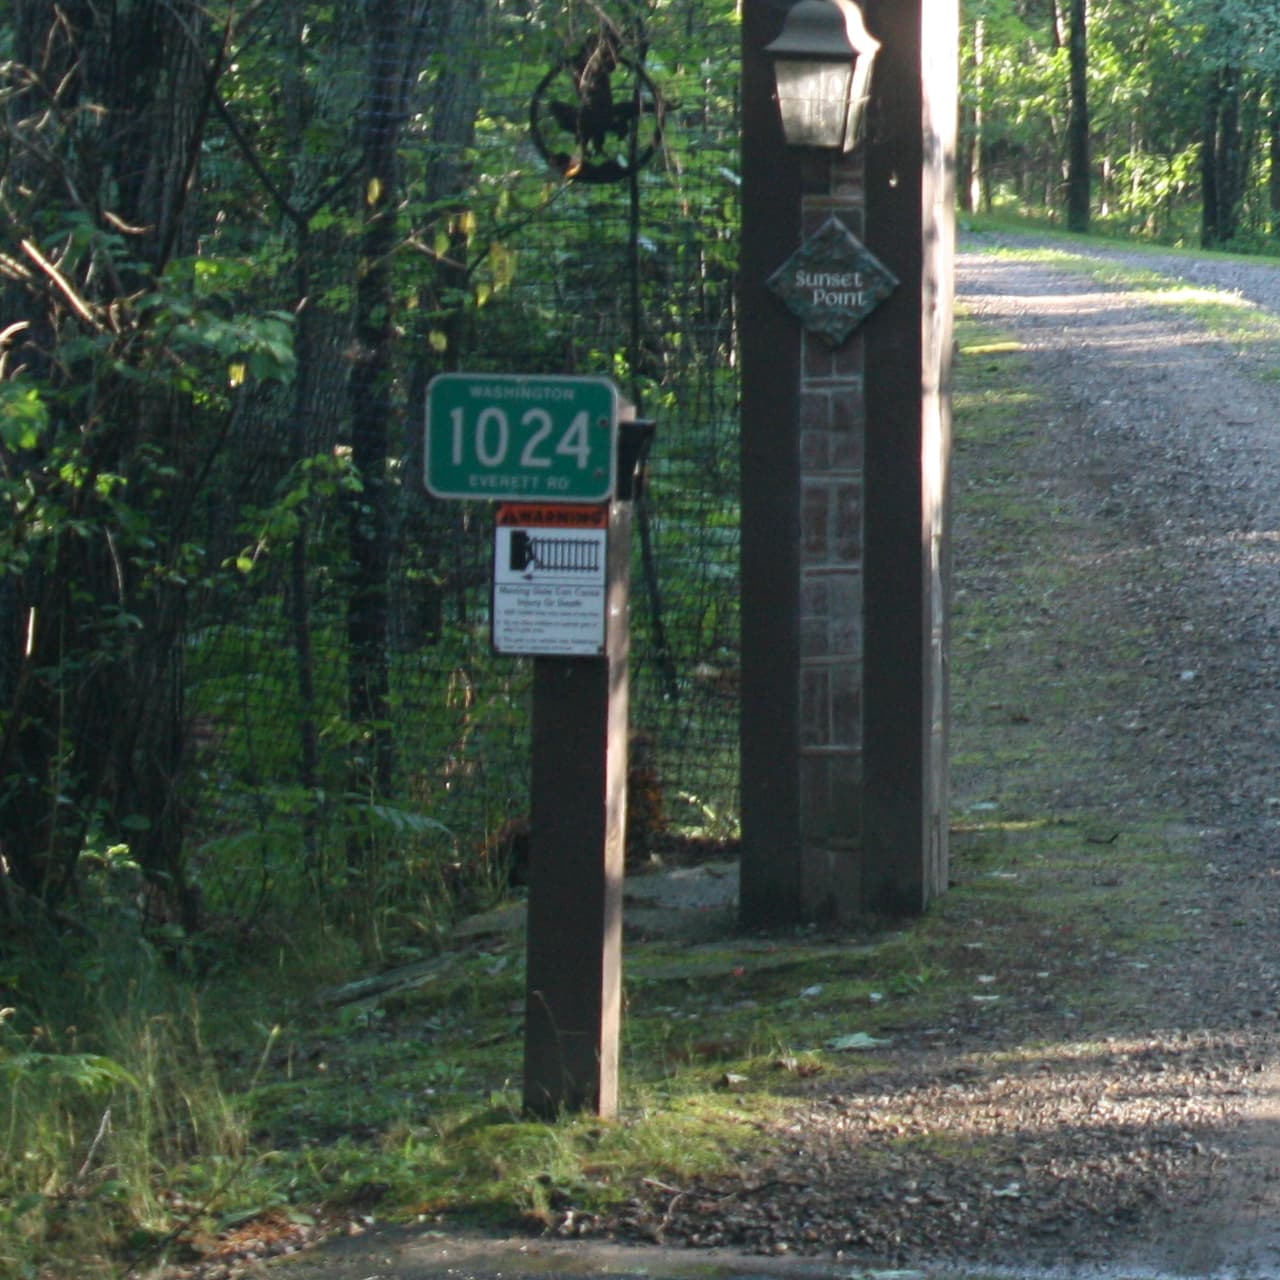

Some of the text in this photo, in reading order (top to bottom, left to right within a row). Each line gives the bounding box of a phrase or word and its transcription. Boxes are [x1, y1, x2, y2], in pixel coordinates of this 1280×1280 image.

[795, 271, 863, 287] Sunset
[812, 289, 867, 306] Point
[470, 385, 575, 401] WASHINGTON
[449, 407, 591, 469] 1024
[469, 475, 570, 490] EVERETT RD
